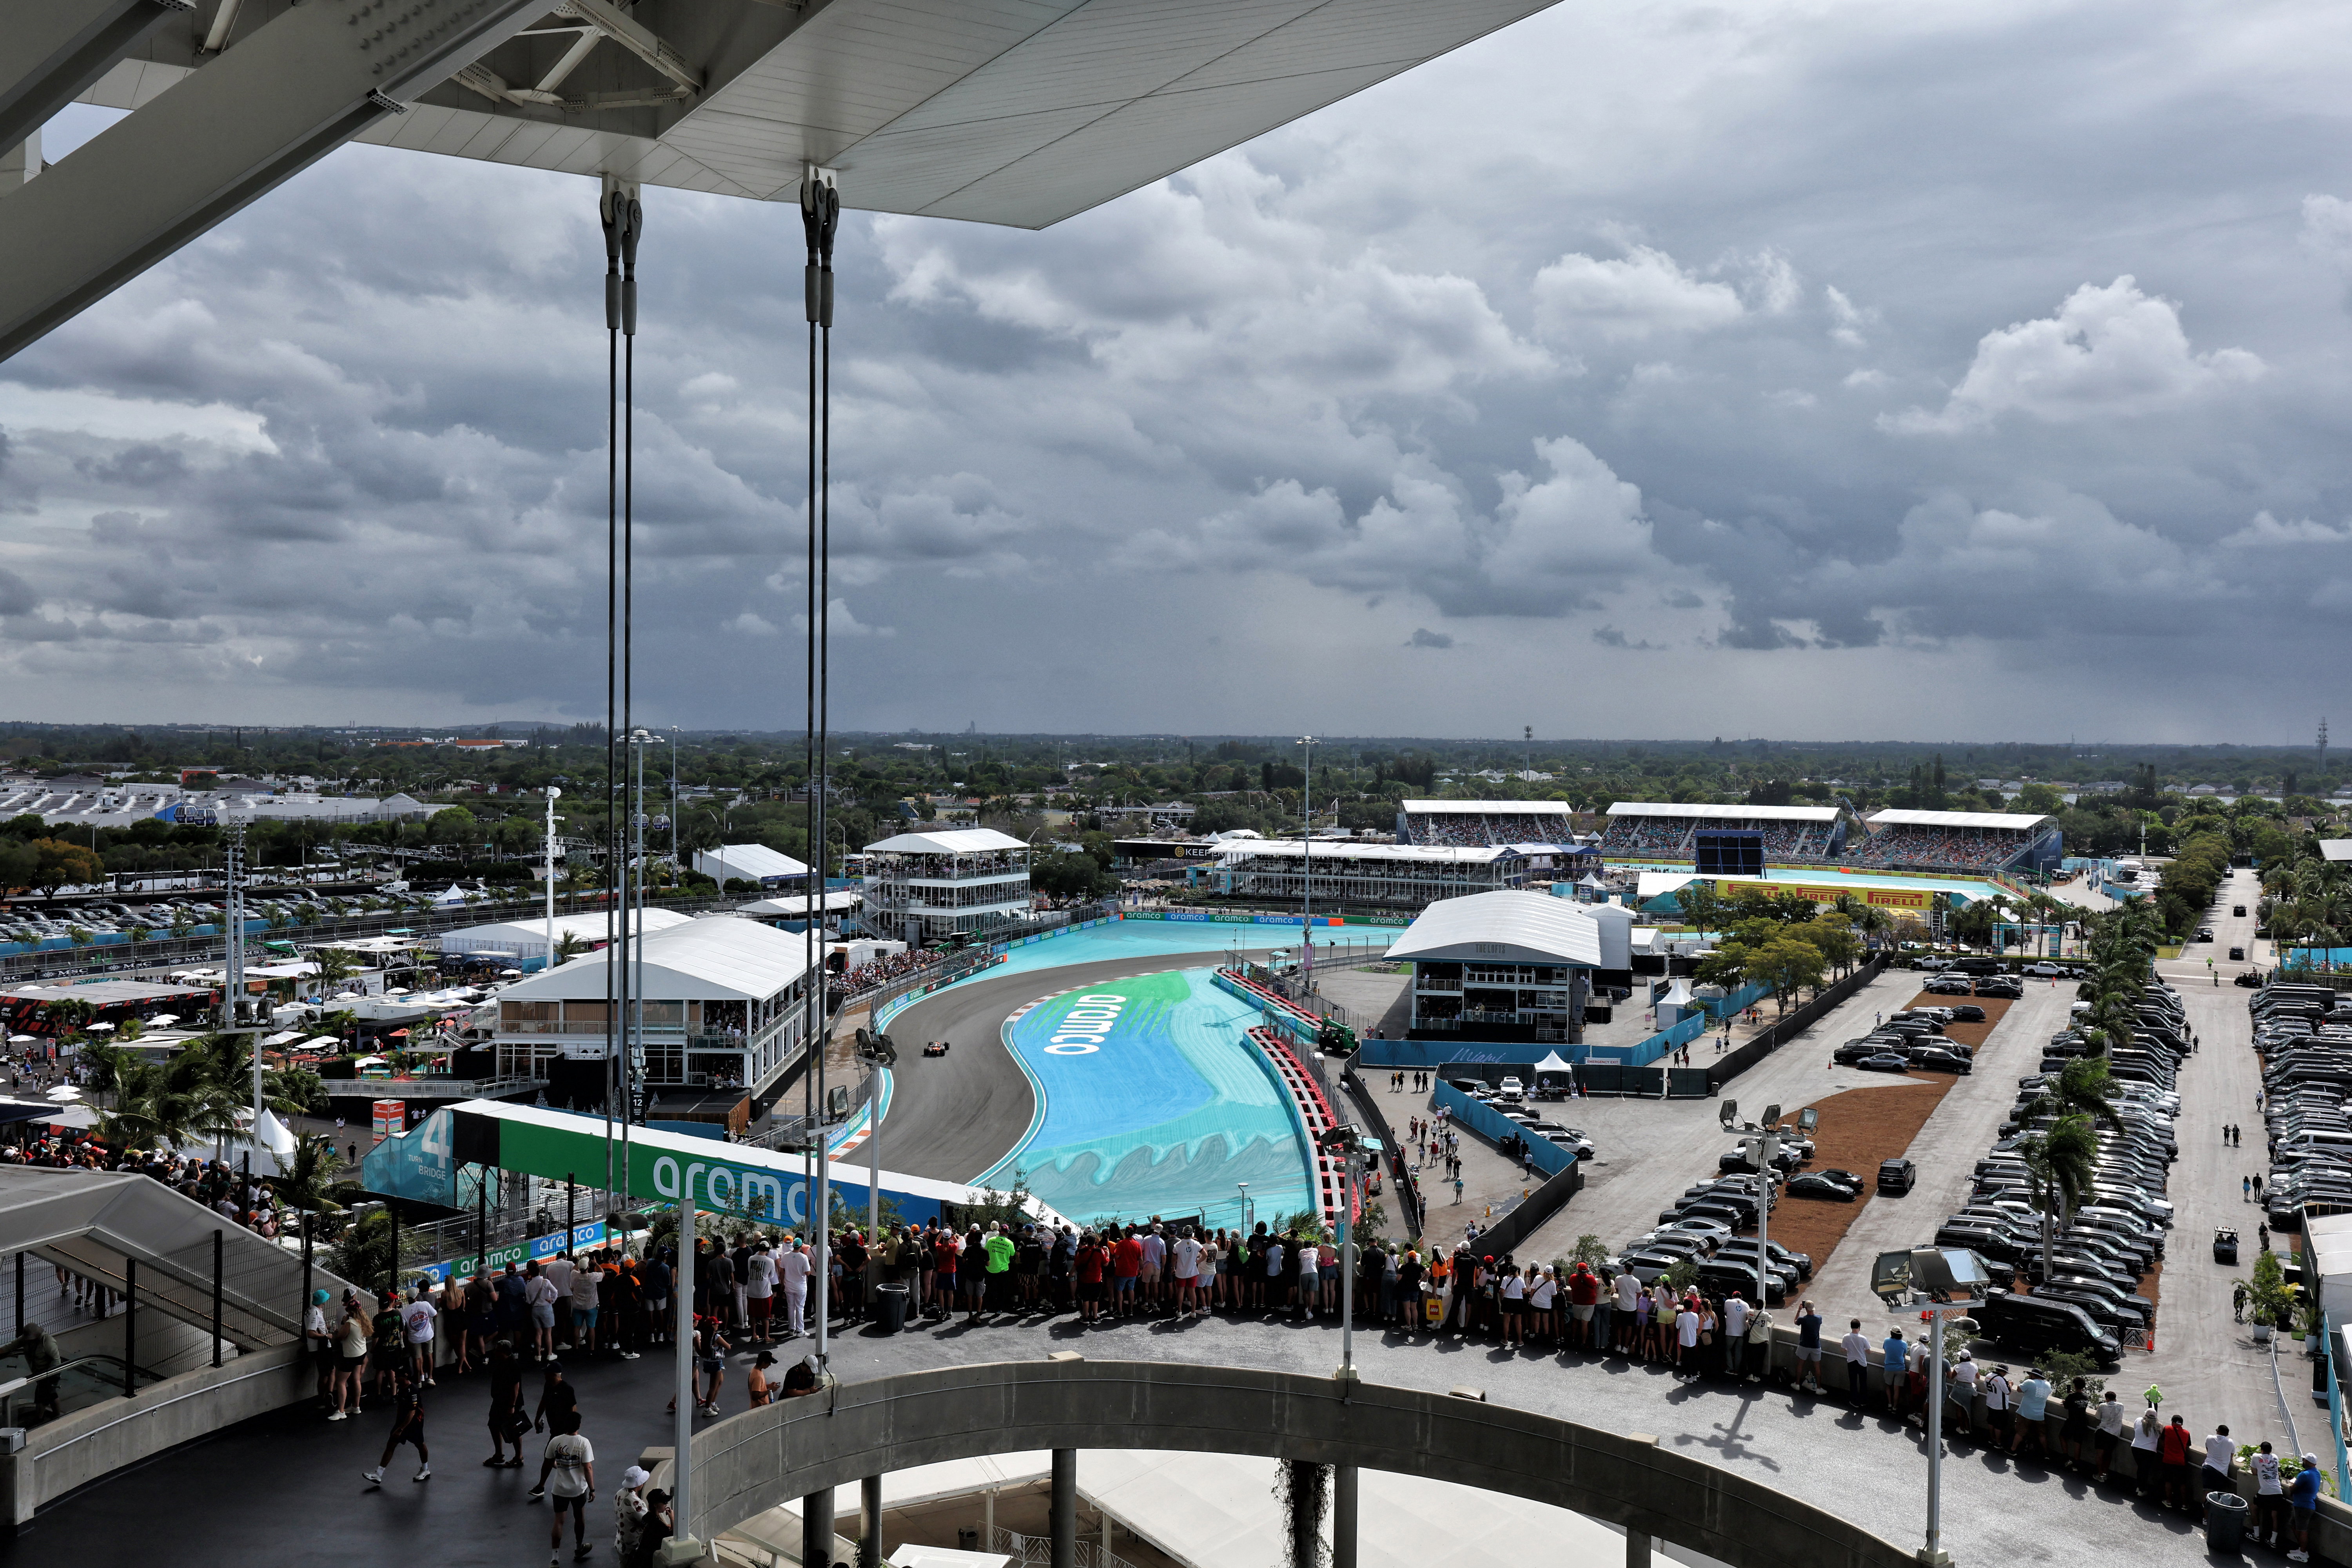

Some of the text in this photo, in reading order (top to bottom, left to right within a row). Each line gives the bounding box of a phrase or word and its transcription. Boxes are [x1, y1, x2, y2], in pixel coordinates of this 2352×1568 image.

[1867, 891, 1923, 907] PIRELLI
[896, 995, 907, 1007] aramco
[910, 989, 923, 1000] aramco
[1234, 987, 1246, 999] aramco
[1249, 995, 1261, 1008] aramco
[1043, 995, 1127, 1055] aramco
[1297, 1021, 1312, 1037] aramco
[1450, 1047, 1506, 1063] Miami
[421, 1109, 450, 1169] 4
[829, 1127, 846, 1146] aramco
[408, 1154, 423, 1163] TURN
[418, 1167, 446, 1180] BRIDGE
[460, 1247, 521, 1273] armco
